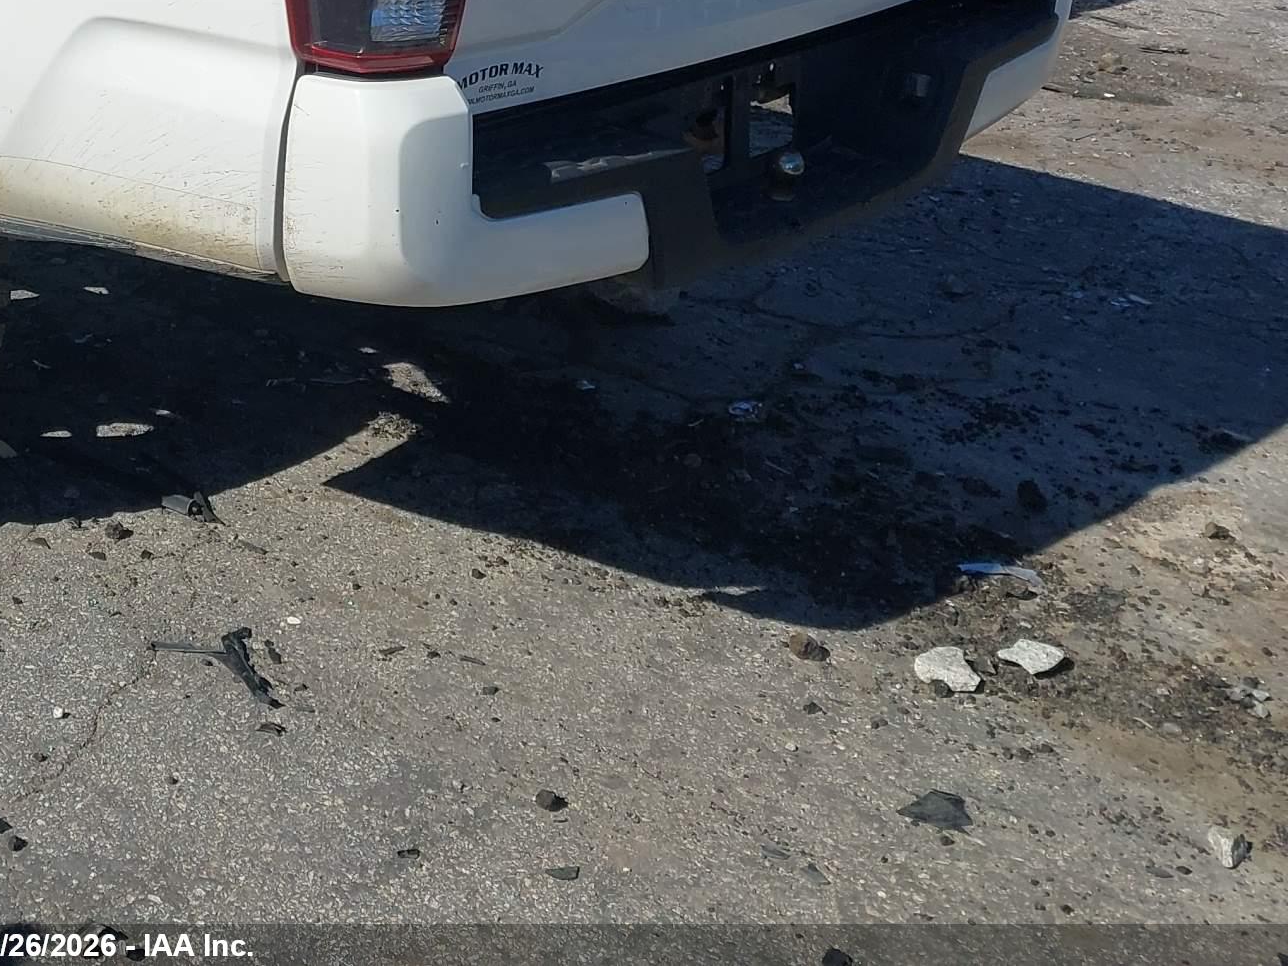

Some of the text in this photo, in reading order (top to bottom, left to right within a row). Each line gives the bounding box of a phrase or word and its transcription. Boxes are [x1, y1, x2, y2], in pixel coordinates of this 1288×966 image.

[457, 62, 544, 90] MOTOR MAX
[508, 80, 517, 88] GA
